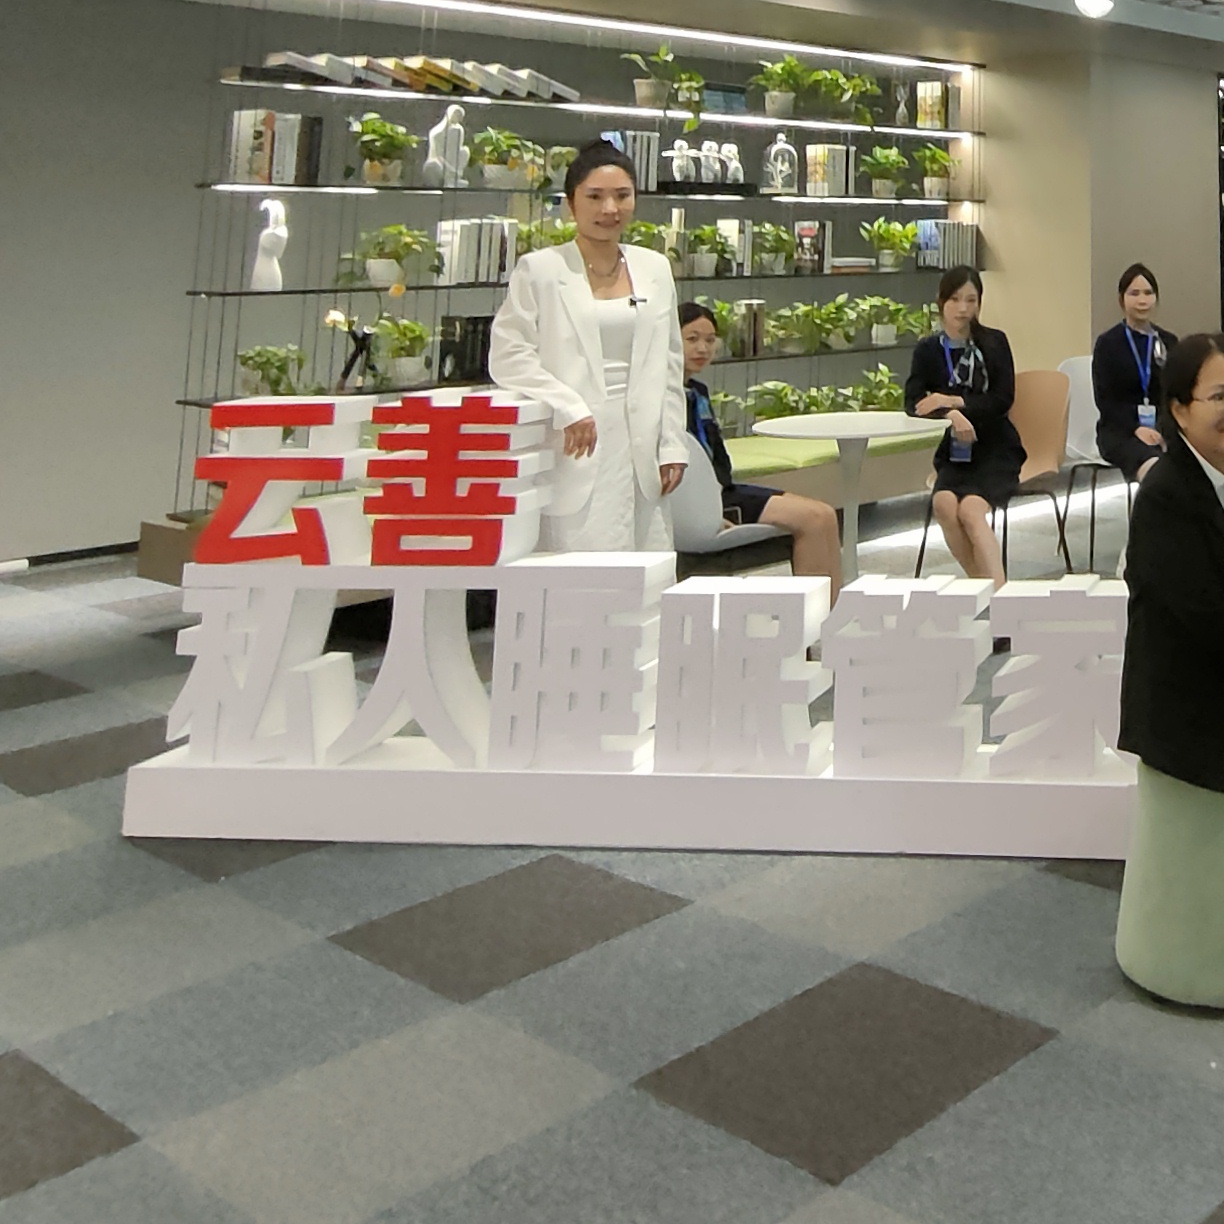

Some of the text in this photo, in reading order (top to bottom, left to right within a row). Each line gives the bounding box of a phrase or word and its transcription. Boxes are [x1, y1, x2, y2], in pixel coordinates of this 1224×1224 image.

[194, 396, 519, 566] 云善
[166, 567, 1128, 777] 私人睡眠管家
